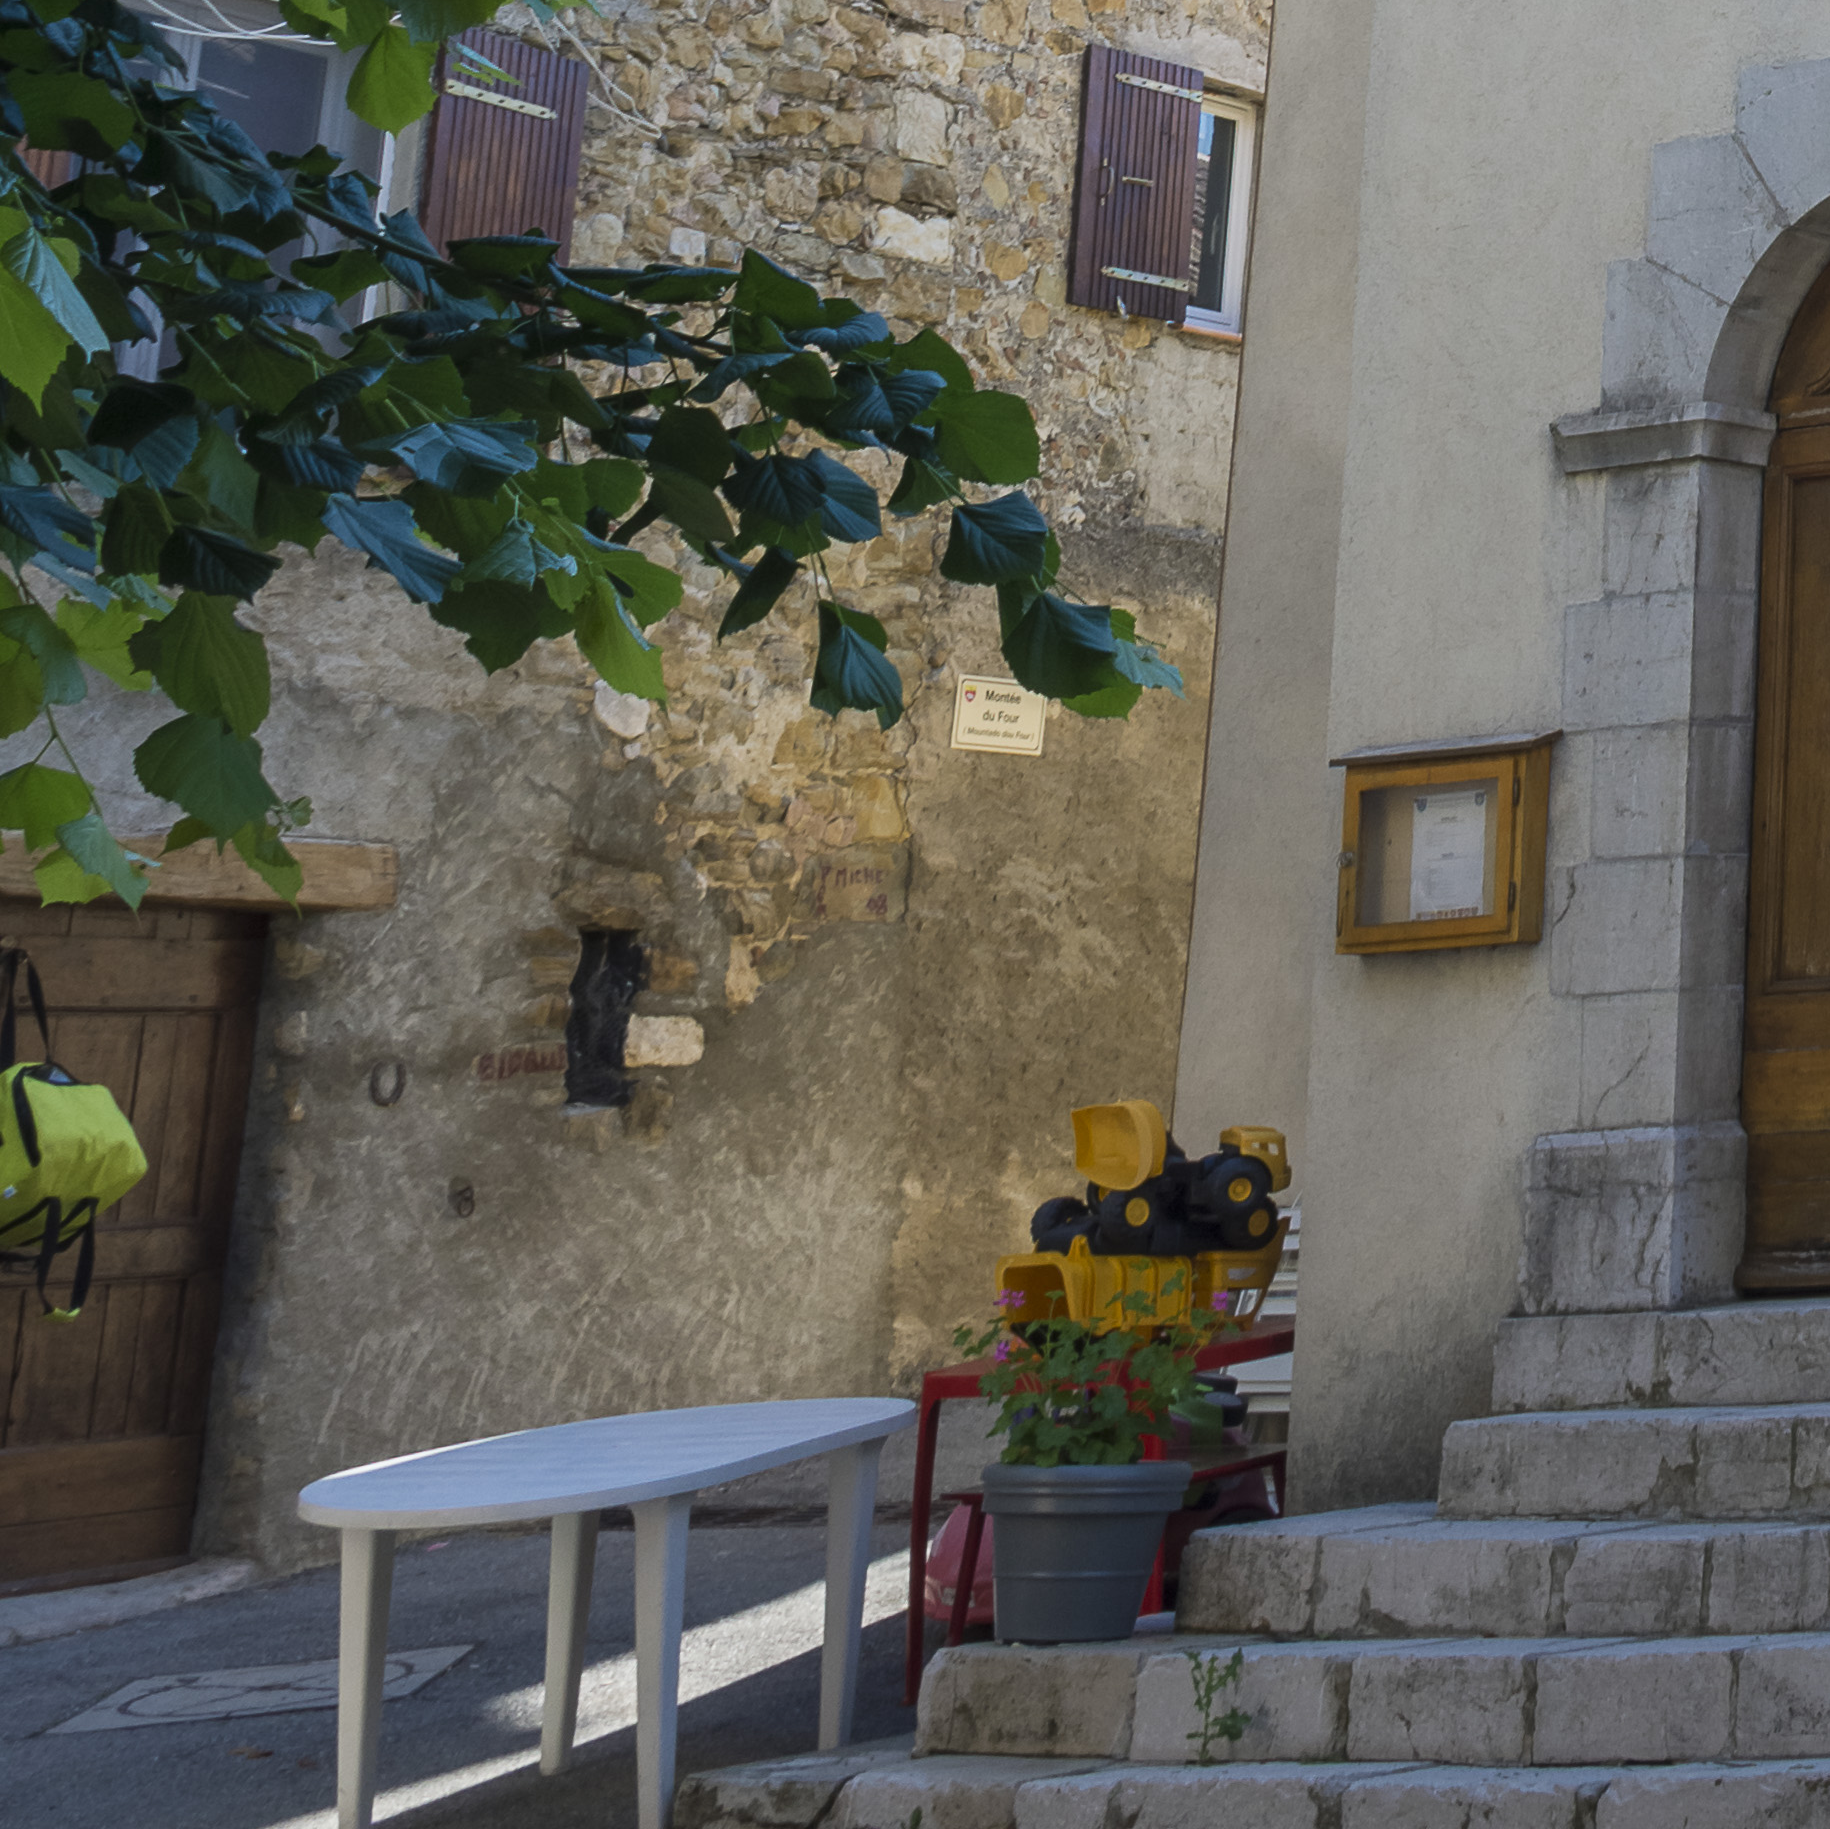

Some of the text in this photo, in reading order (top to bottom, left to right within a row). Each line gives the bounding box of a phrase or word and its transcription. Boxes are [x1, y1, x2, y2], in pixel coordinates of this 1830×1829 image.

[984, 690, 1022, 704] Montée
[982, 710, 1021, 723] du Four
